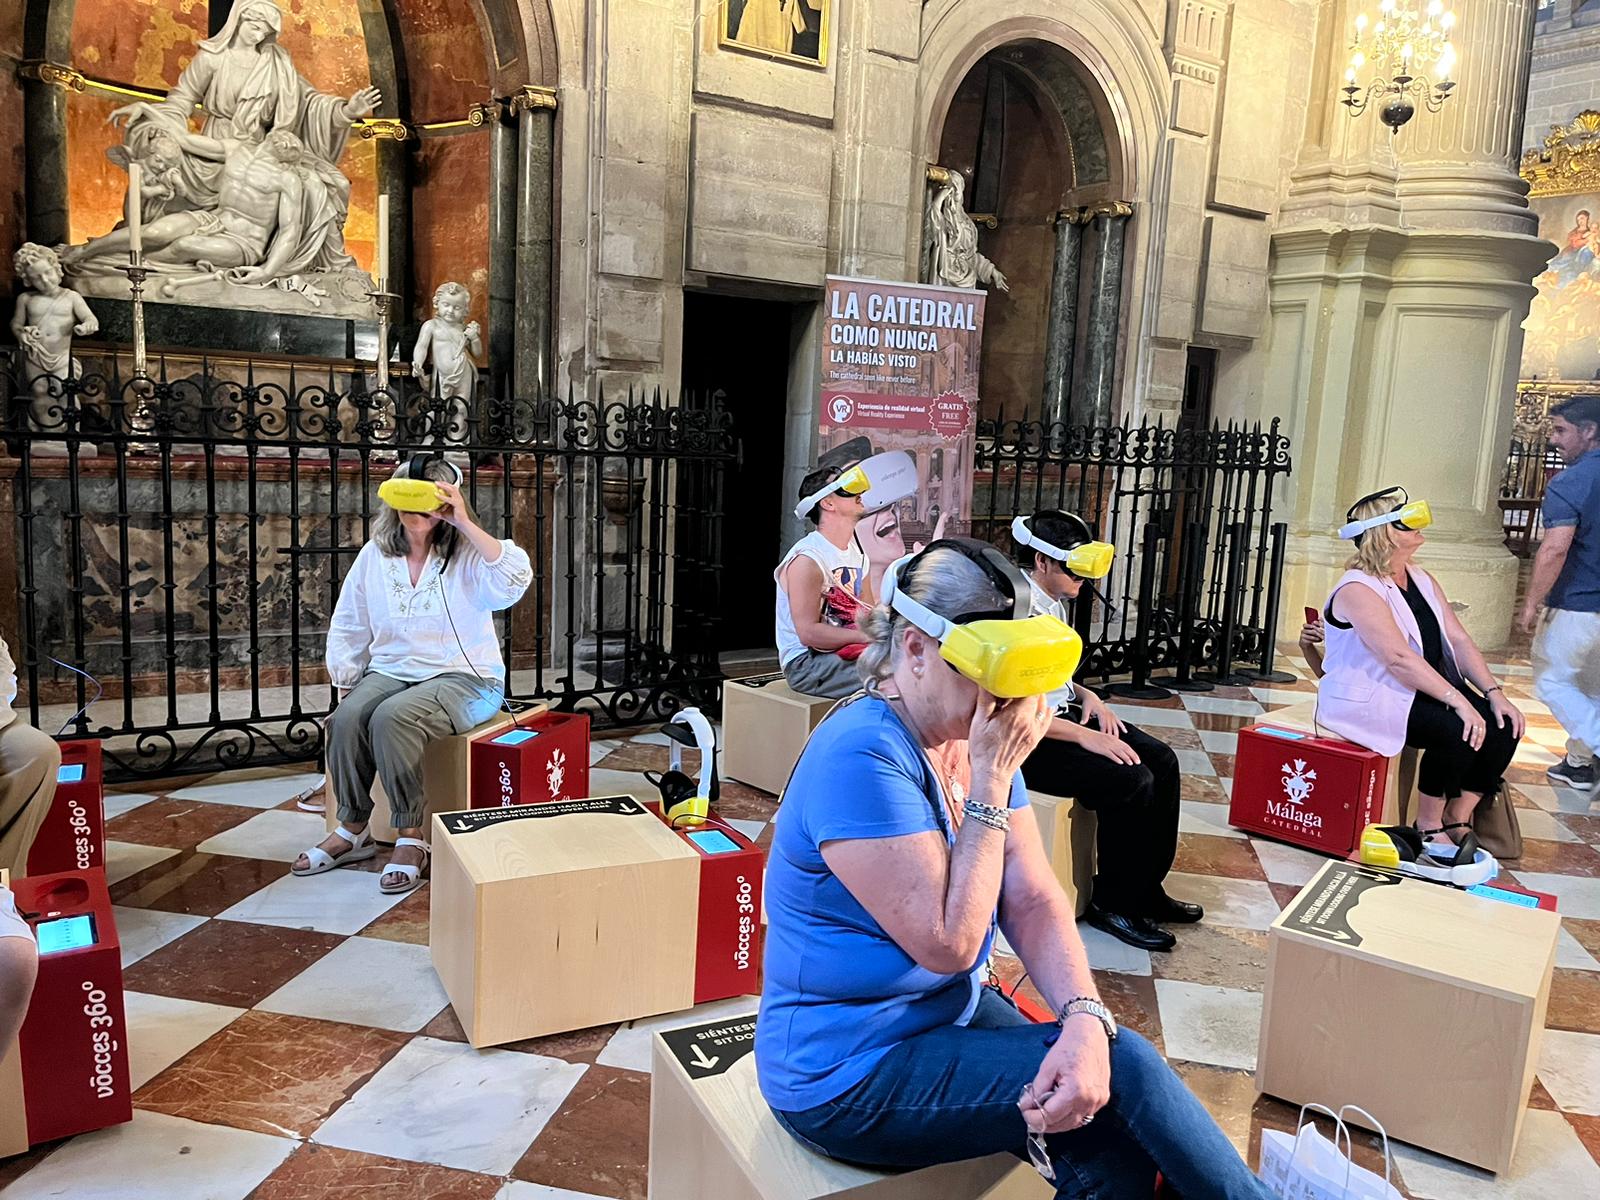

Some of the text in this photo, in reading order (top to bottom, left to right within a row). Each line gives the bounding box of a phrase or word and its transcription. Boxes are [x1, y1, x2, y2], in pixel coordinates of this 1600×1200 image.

[831, 290, 977, 331] LA CATEDRAL
[830, 323, 938, 352] COMO NUNCA
[830, 349, 917, 369] LA HABÍAS VISTO
[836, 404, 848, 413] VR
[857, 402, 884, 412] Experiencia
[884, 403, 891, 411] de
[891, 403, 910, 412] realidad
[937, 402, 964, 411] GRATIS
[941, 412, 960, 420] FREE
[1265, 799, 1322, 828] Málaga
[1263, 816, 1322, 838] CATEDRAL
[713, 1032, 756, 1046] SIT DO
